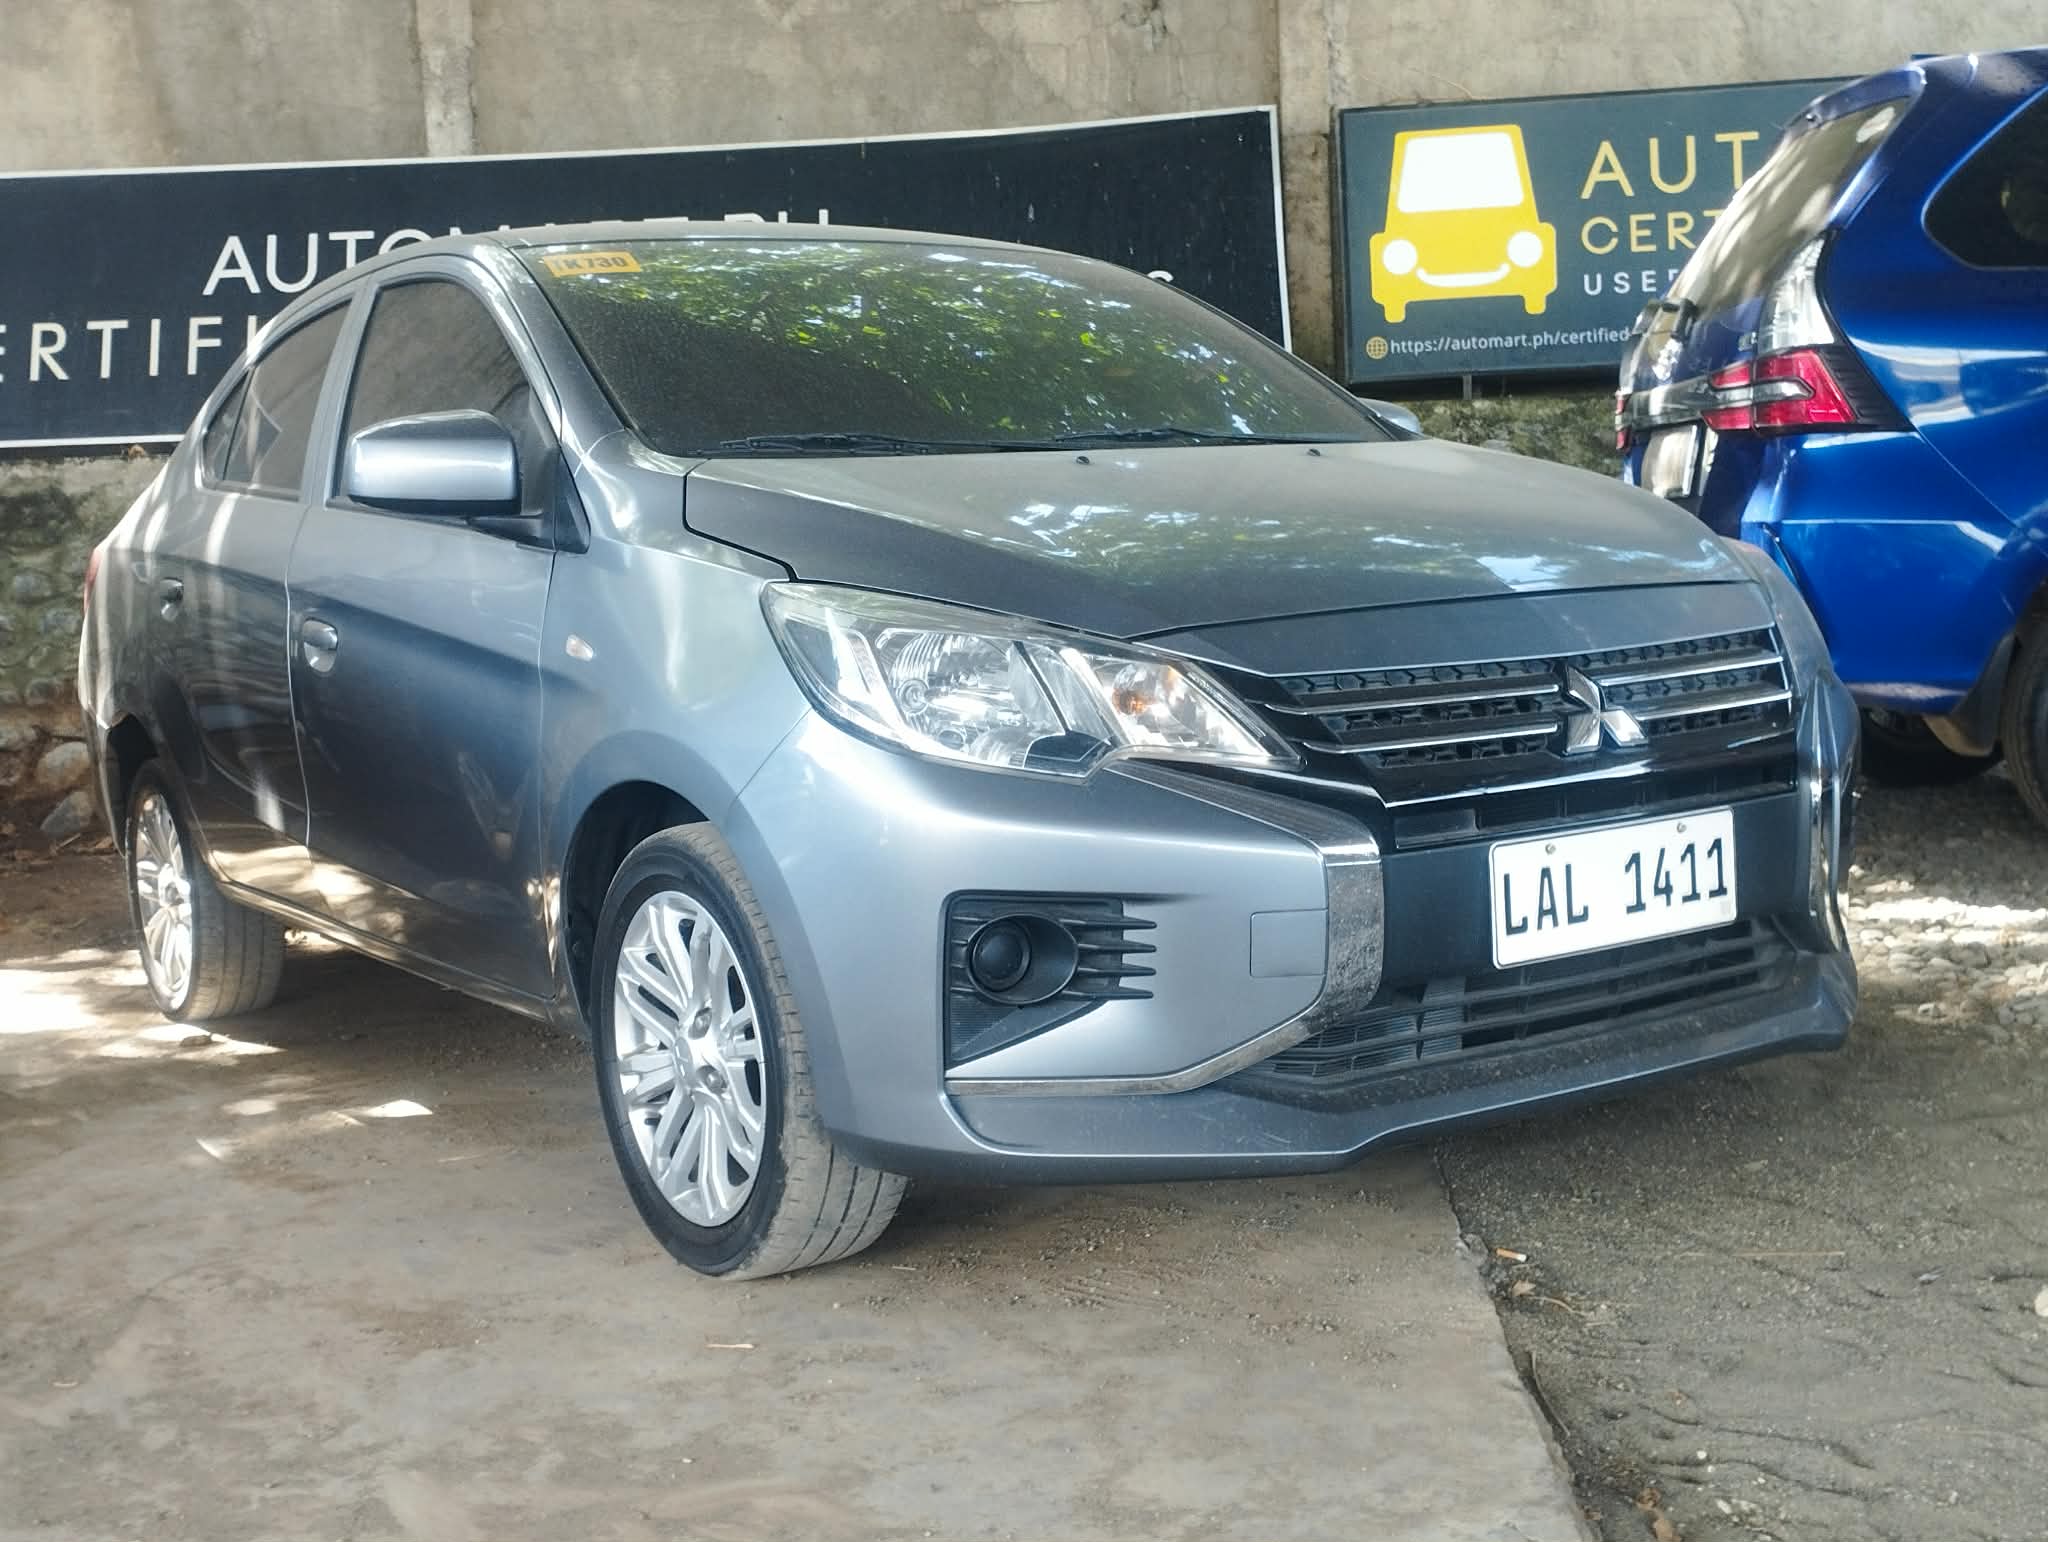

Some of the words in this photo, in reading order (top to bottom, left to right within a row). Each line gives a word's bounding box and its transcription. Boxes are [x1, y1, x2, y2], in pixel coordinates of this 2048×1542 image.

[1580, 131, 1760, 200] AUT
[0, 314, 258, 382] RTIFI
[1503, 863, 1589, 936] LAL
[1624, 837, 1729, 915] 1411
